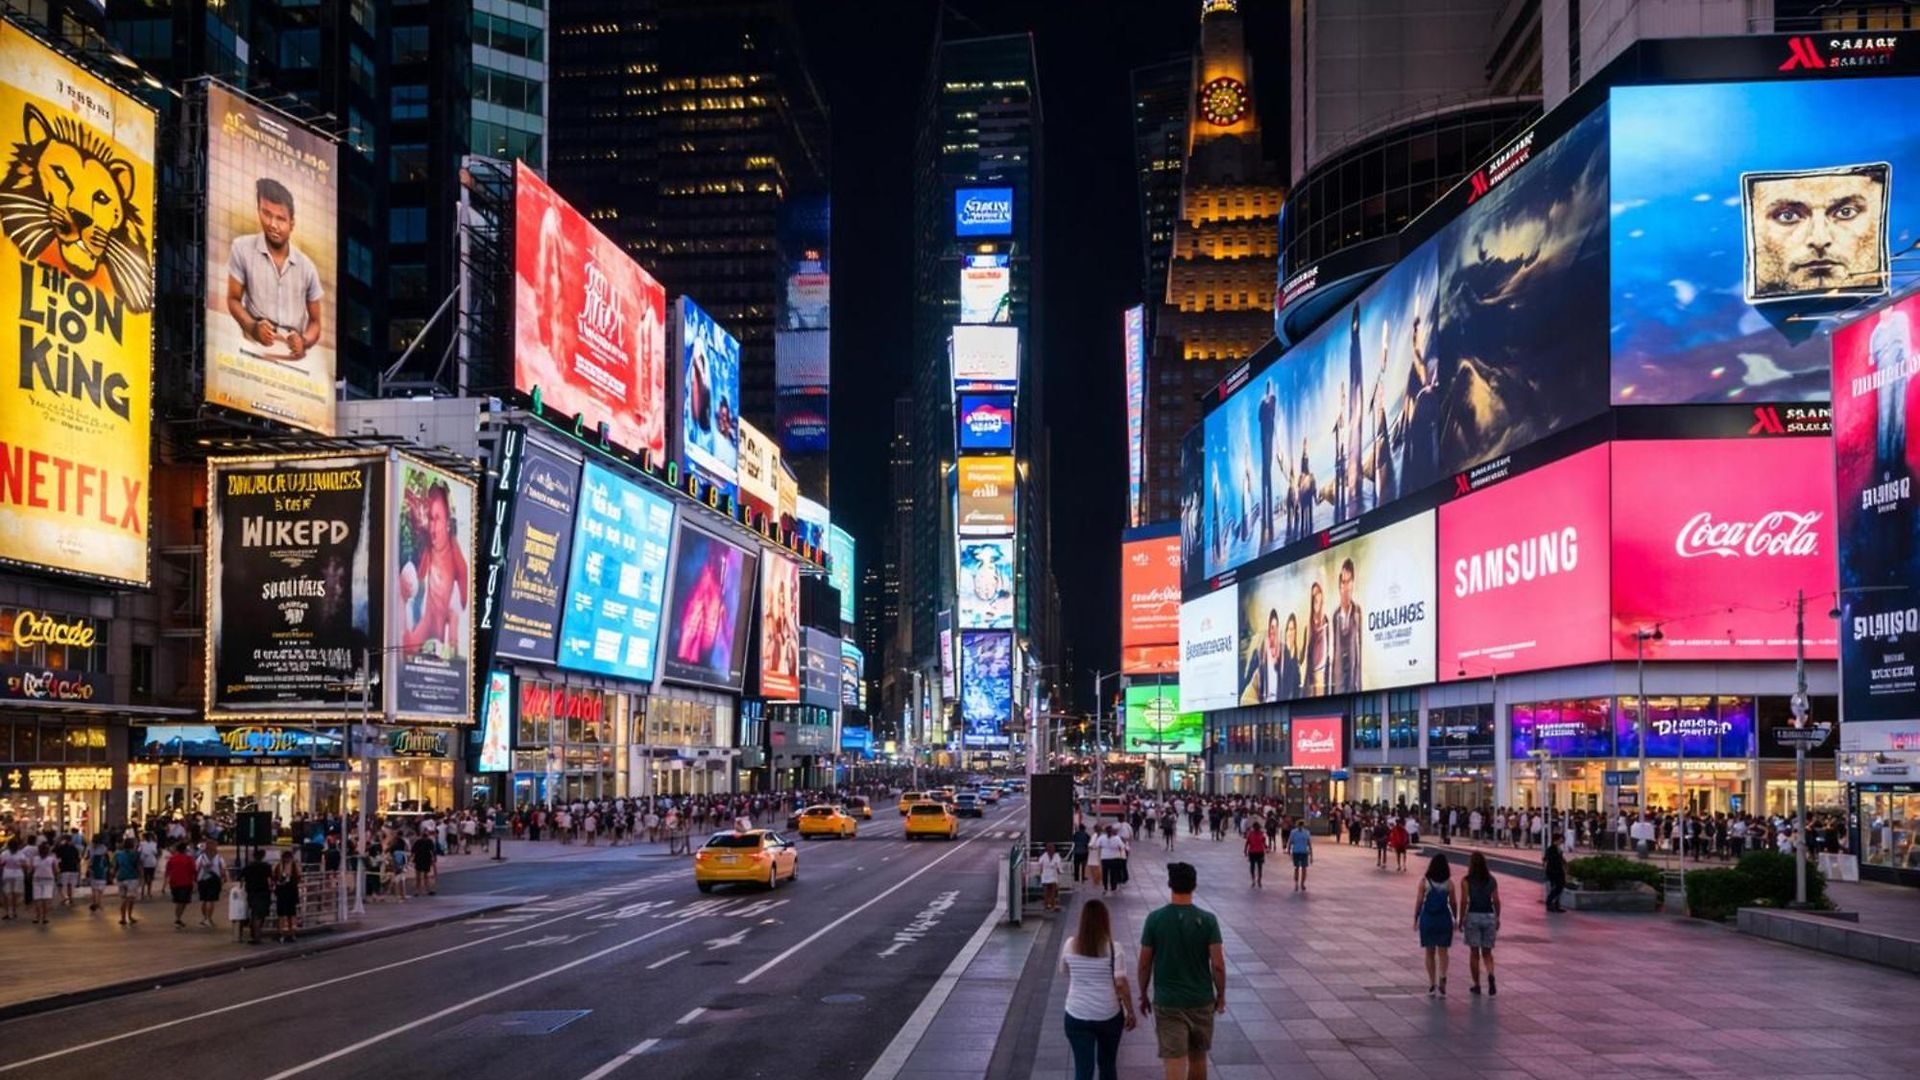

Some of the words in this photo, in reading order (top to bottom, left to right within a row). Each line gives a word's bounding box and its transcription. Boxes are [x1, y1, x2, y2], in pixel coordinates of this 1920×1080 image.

[0, 441, 142, 535] NETFLX
[242, 516, 350, 547] WIKEPD
[1455, 526, 1578, 598] SAMSUNG
